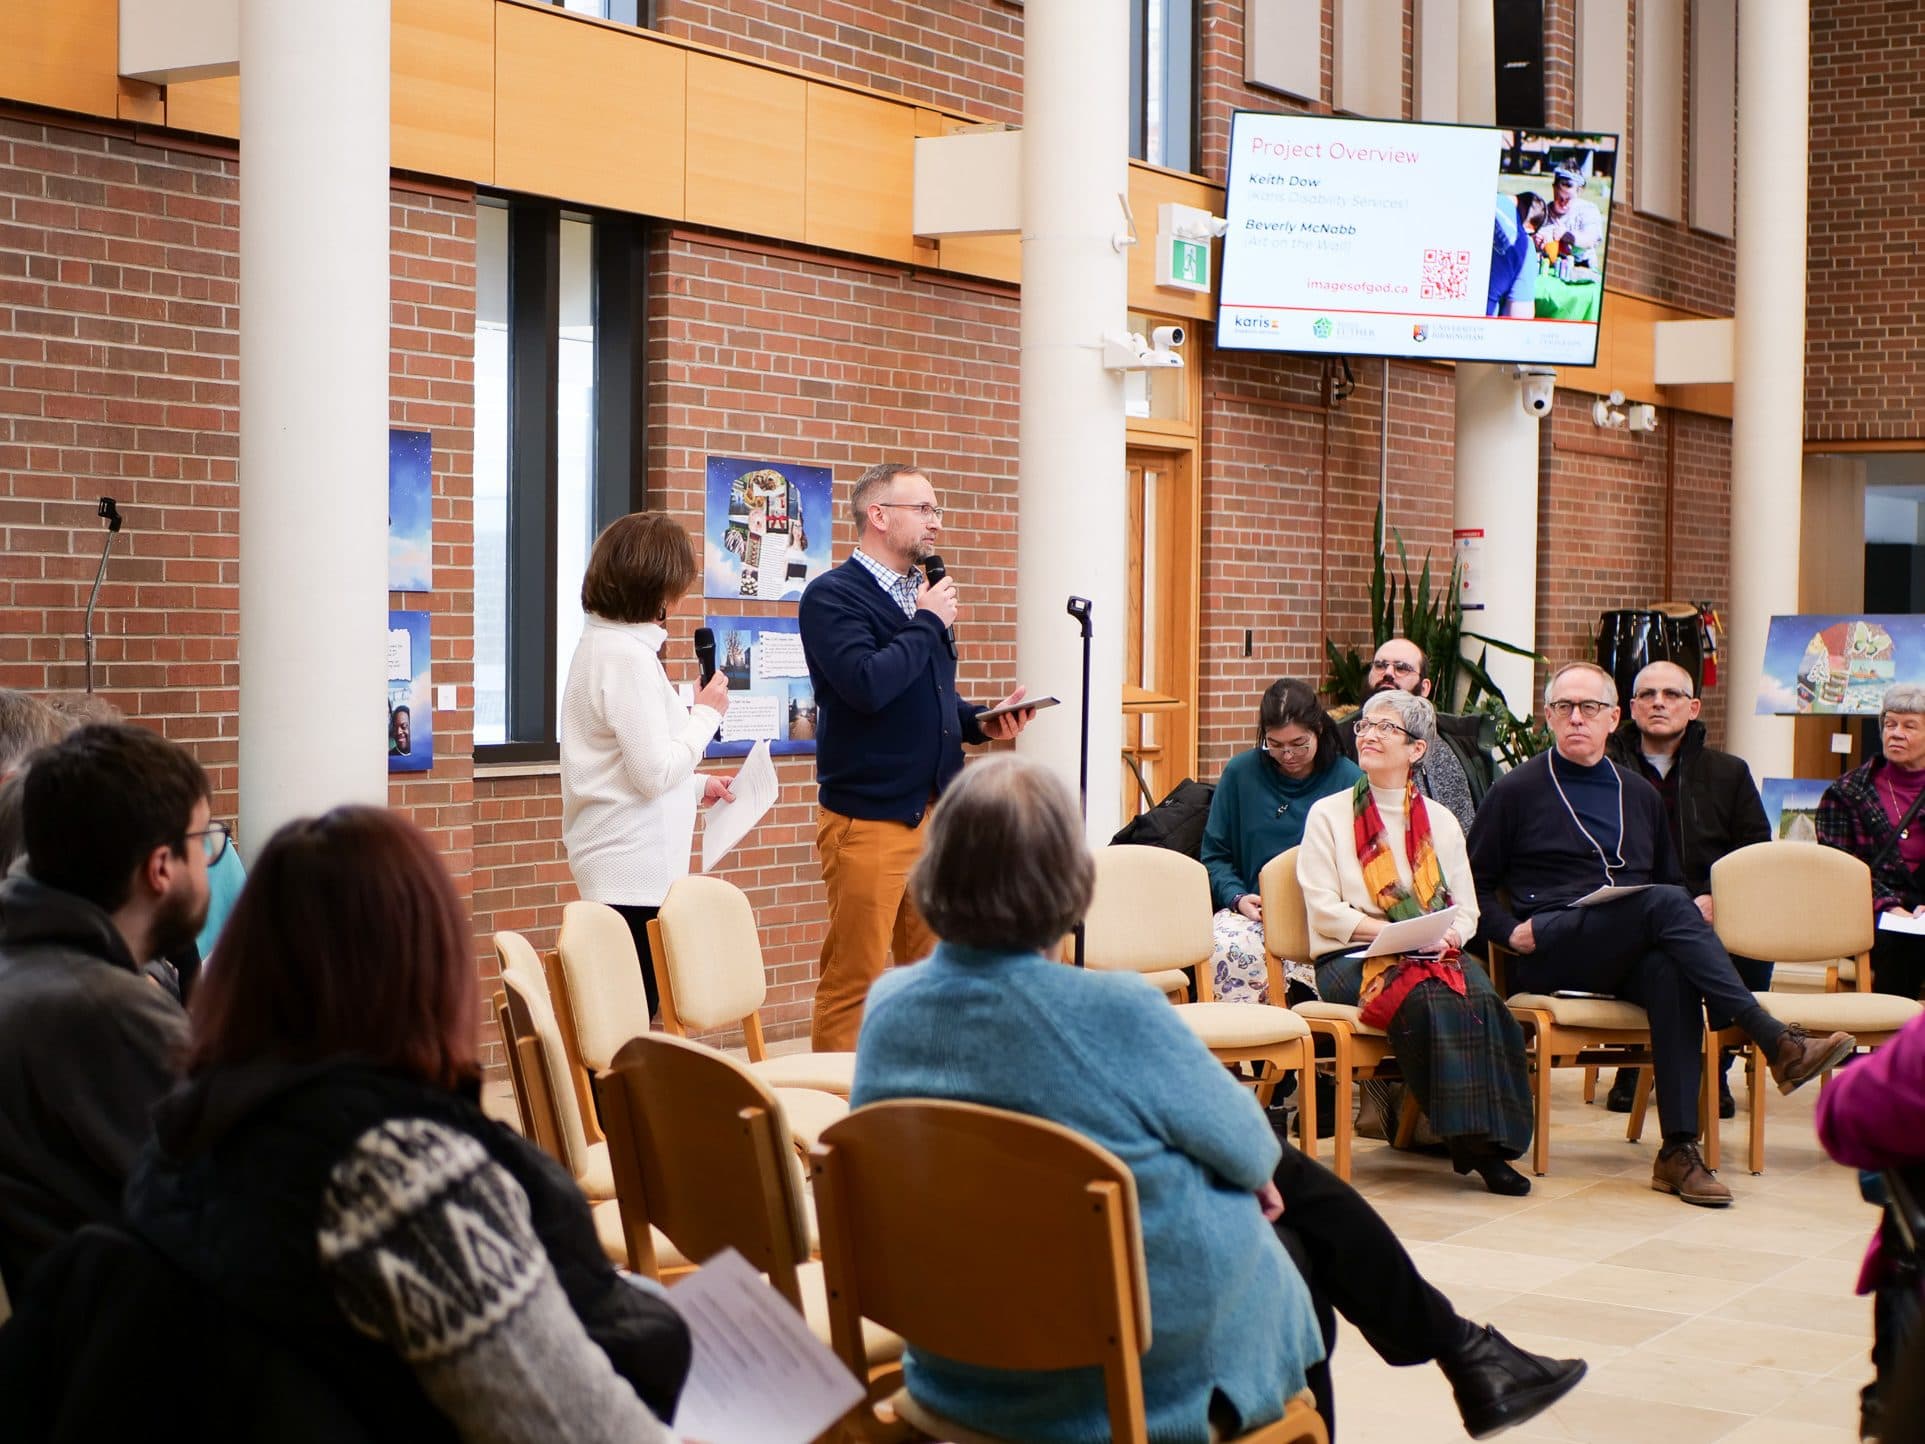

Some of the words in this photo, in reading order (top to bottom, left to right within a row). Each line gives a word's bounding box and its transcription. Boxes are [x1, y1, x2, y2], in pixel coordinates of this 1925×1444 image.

[1251, 137, 1321, 160] Project
[1329, 142, 1419, 164] Overview
[1249, 173, 1285, 186] Keith
[1289, 176, 1321, 188] Dow
[1245, 219, 1297, 234] Beverly
[1300, 223, 1357, 236] McNabb
[1306, 278, 1409, 295] imagesofgod.ca
[1235, 314, 1270, 328] karis
